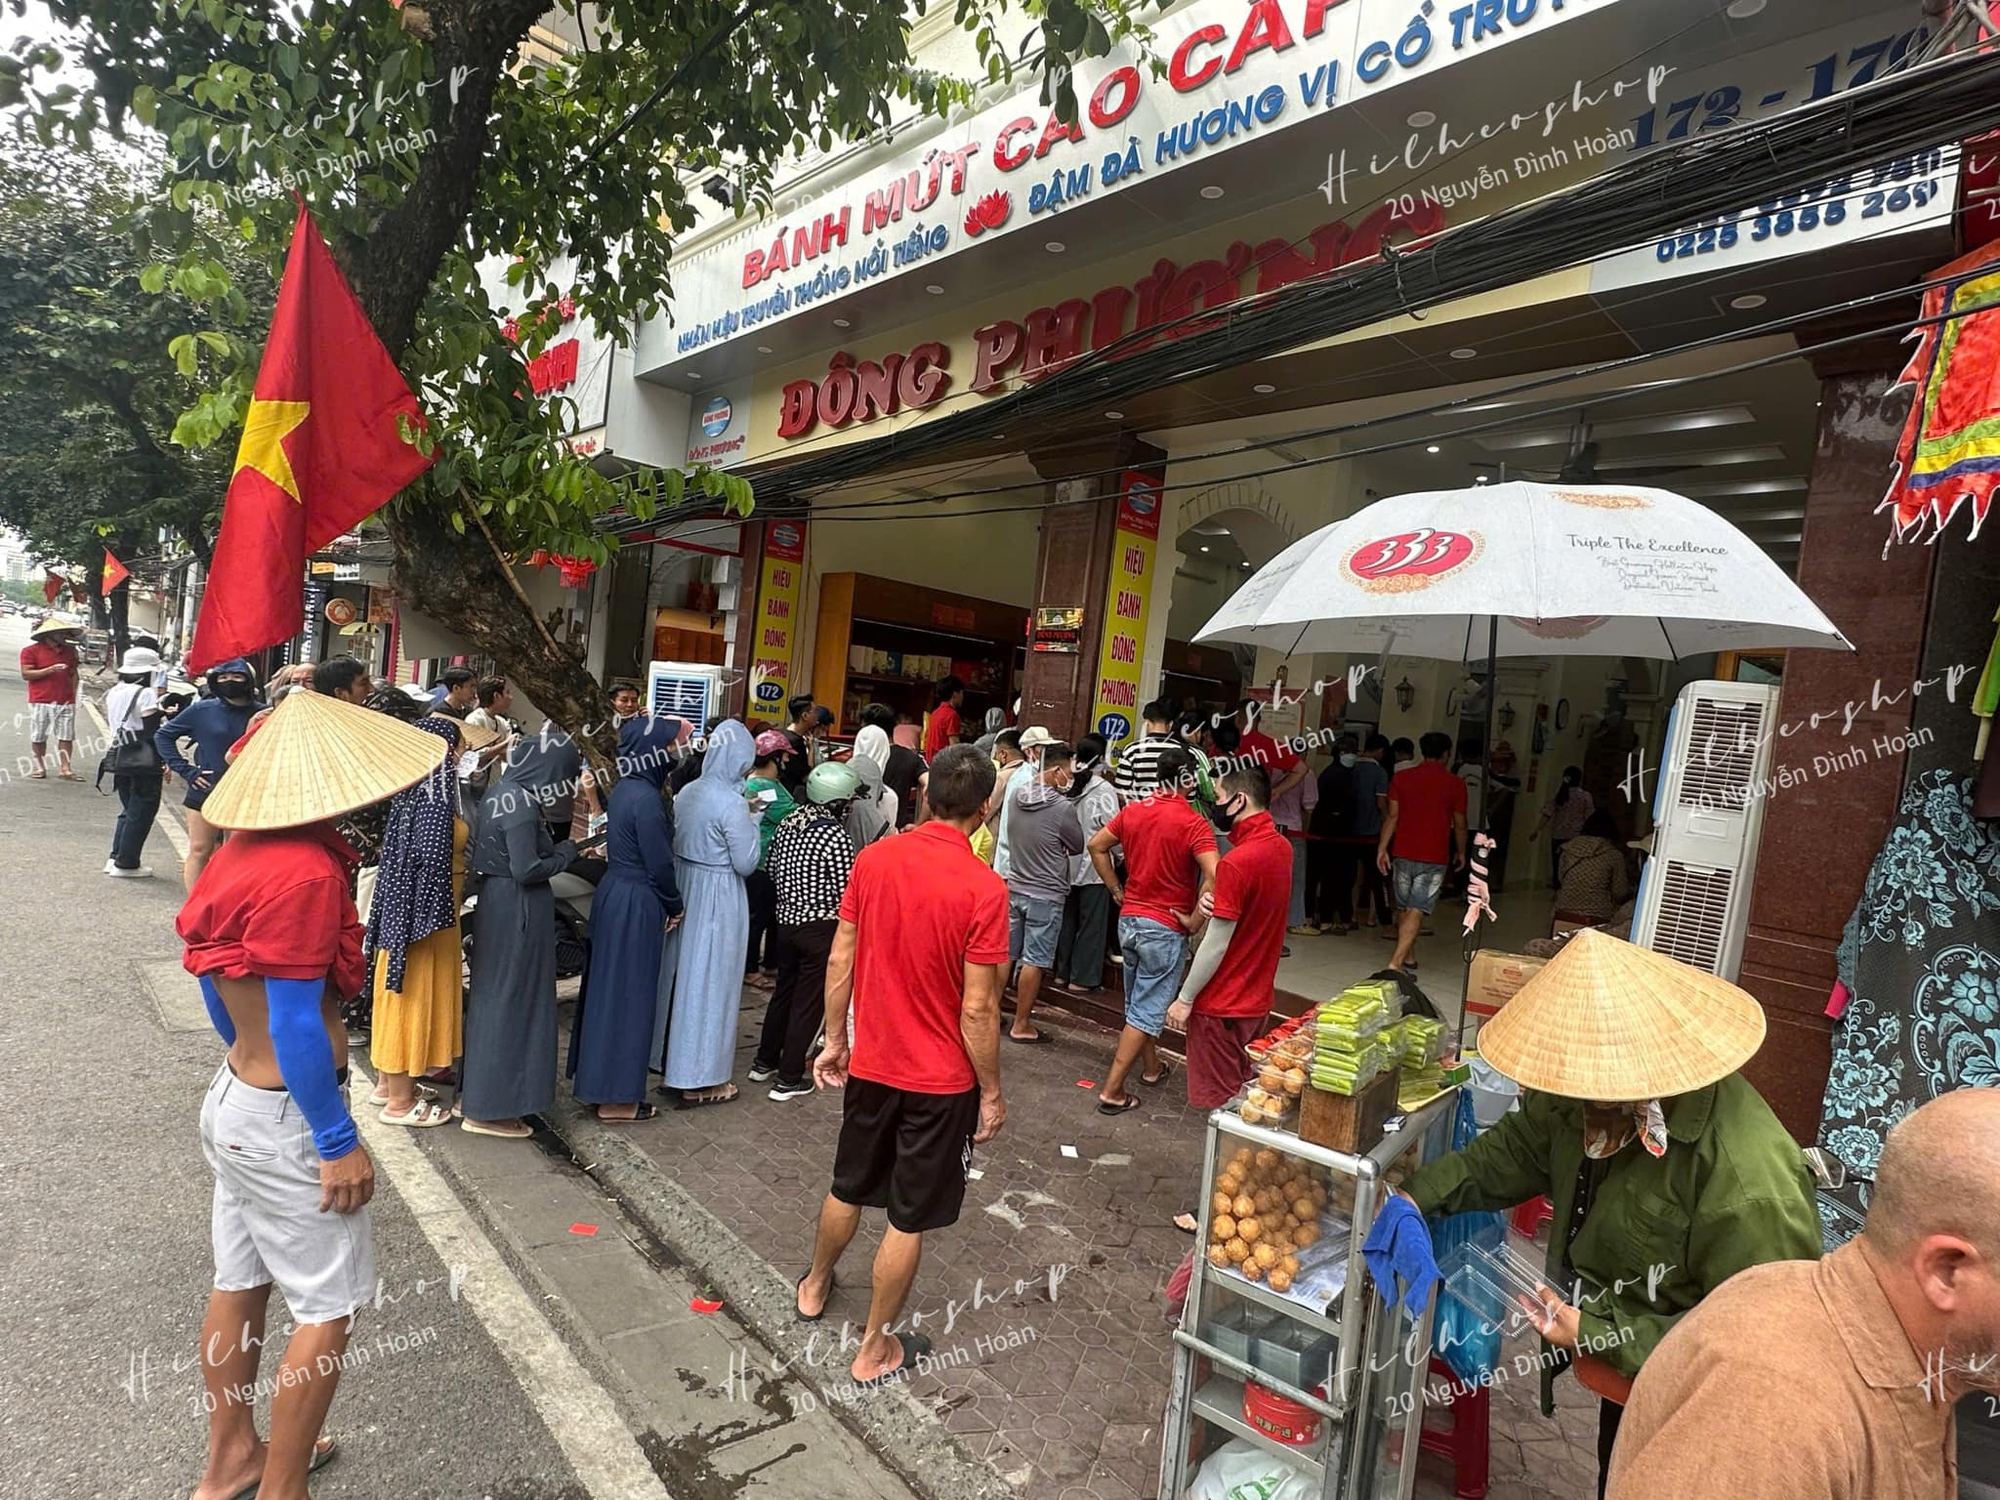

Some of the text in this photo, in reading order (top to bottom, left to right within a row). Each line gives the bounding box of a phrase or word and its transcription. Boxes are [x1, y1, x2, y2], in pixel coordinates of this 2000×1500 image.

[1029, 162, 1093, 216] ĐẬM
[1101, 136, 1144, 187] ĐÀ
[1155, 83, 1287, 165] HƯƠNG
[1299, 60, 1341, 107] VỊ
[1356, 0, 1434, 83] CỔ
[1627, 84, 1742, 152] 172
[741, 204, 851, 290] BÁNH
[862, 141, 981, 236] MỨT
[993, 64, 1141, 173] CAO
[1657, 222, 1738, 263] 0225
[1751, 199, 1846, 241] 3855
[741, 282, 792, 328] TRUYỀN
[794, 263, 852, 307] THỐNG
[854, 237, 889, 284] NỔI
[892, 221, 949, 268] TIẾNG
[777, 341, 952, 440] ĐÔNG
[1358, 527, 1455, 575] 333
[1566, 533, 1728, 555] Triple The Excellence
[1124, 544, 1145, 579] HIỆU
[772, 567, 791, 591] HIỆU
[766, 596, 789, 618] BÁNH
[1116, 587, 1141, 621] BÁNH
[763, 625, 787, 649] ĐÔNG
[1110, 631, 1136, 664] ĐÔNG
[759, 683, 779, 699] 172
[1100, 678, 1137, 708] PHƯƠNG
[1104, 716, 1125, 738] 172
